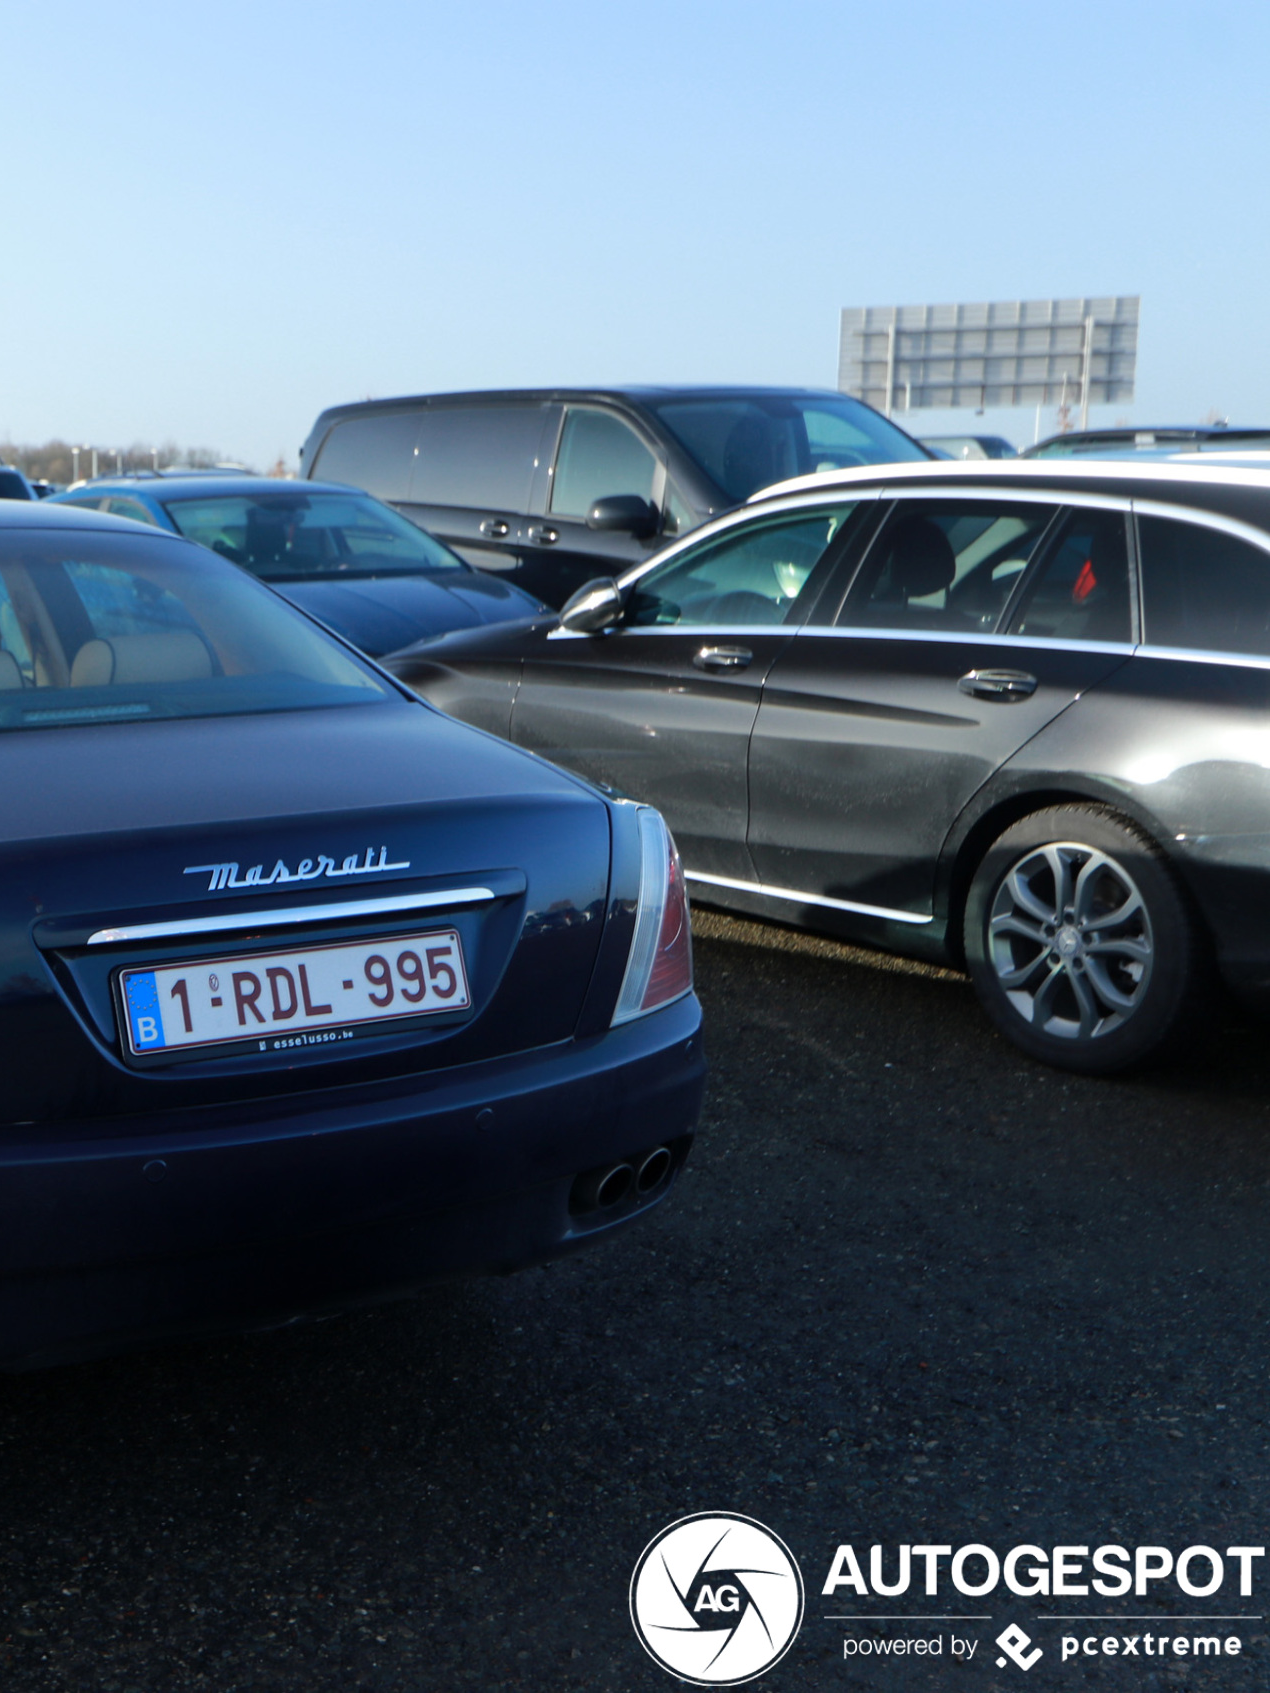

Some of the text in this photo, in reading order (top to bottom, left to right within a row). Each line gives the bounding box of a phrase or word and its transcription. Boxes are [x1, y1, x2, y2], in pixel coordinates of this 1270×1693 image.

[183, 846, 410, 891] Maserati
[137, 1016, 158, 1042] B
[273, 1030, 354, 1049] esselusso.be
